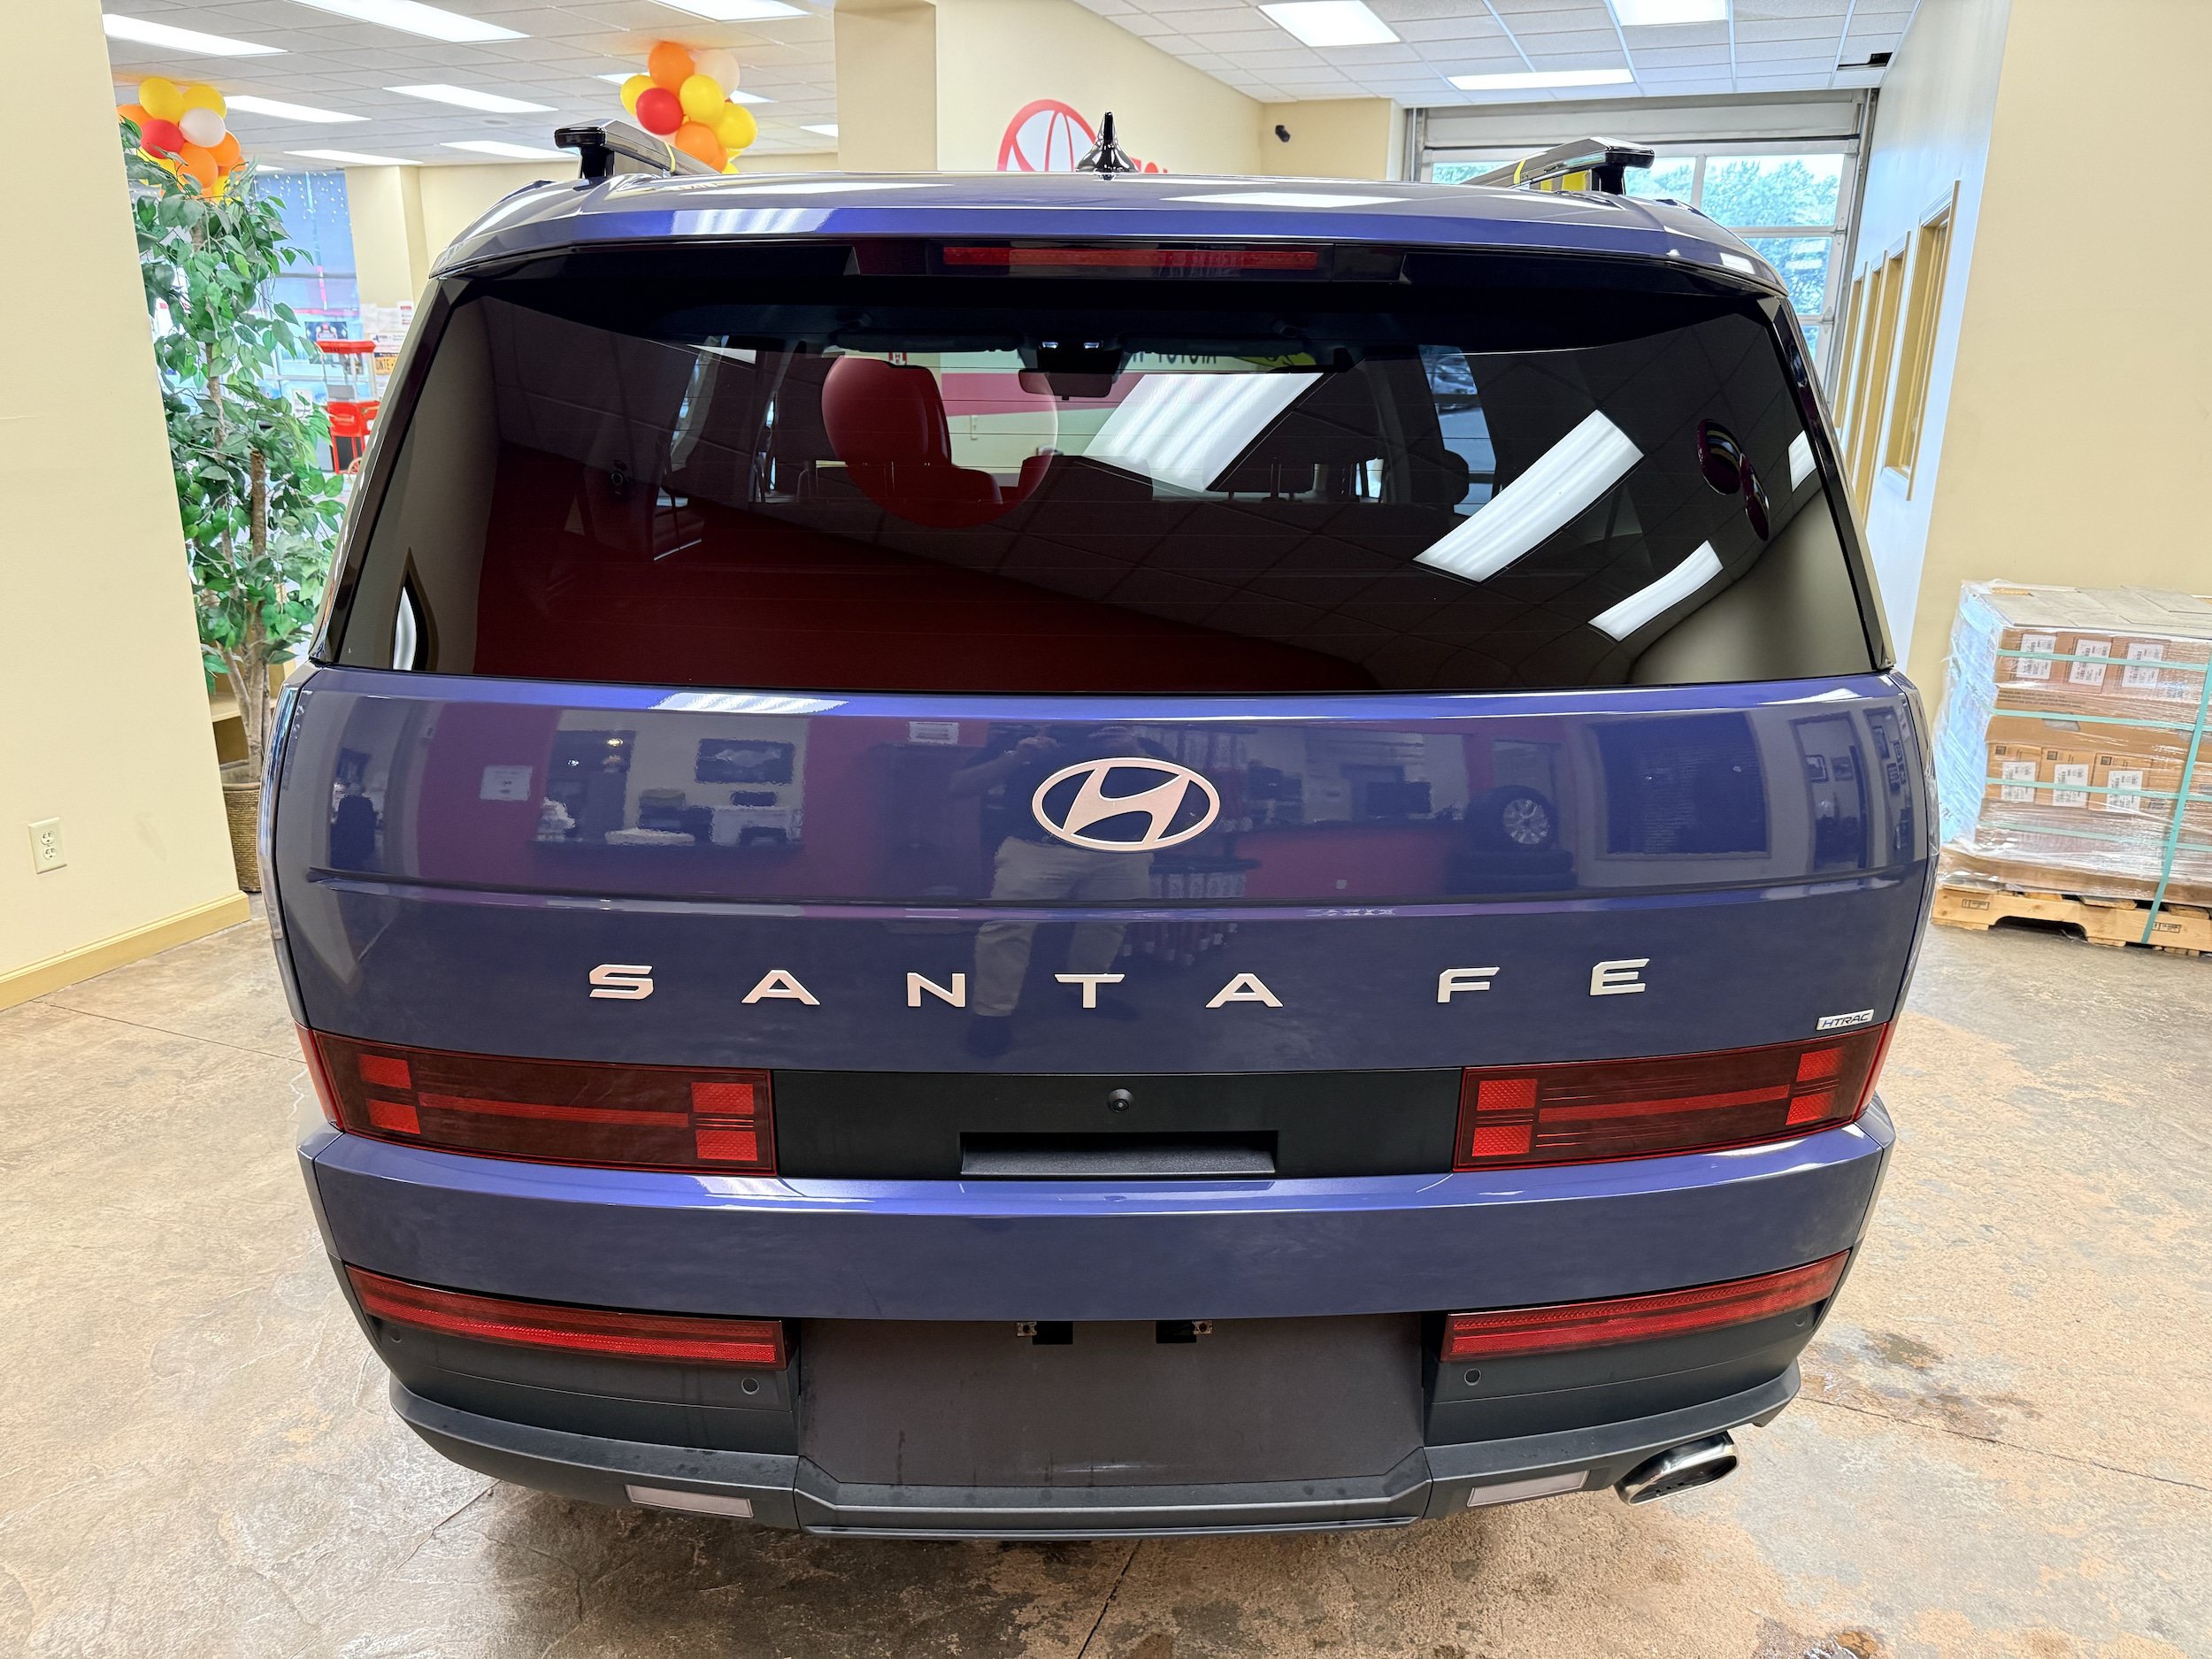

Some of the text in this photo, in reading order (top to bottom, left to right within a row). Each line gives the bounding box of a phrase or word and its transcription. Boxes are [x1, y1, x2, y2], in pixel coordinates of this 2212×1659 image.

[588, 957, 1650, 1008] SANTA FE
[1821, 1012, 1870, 1028] HTRAC
